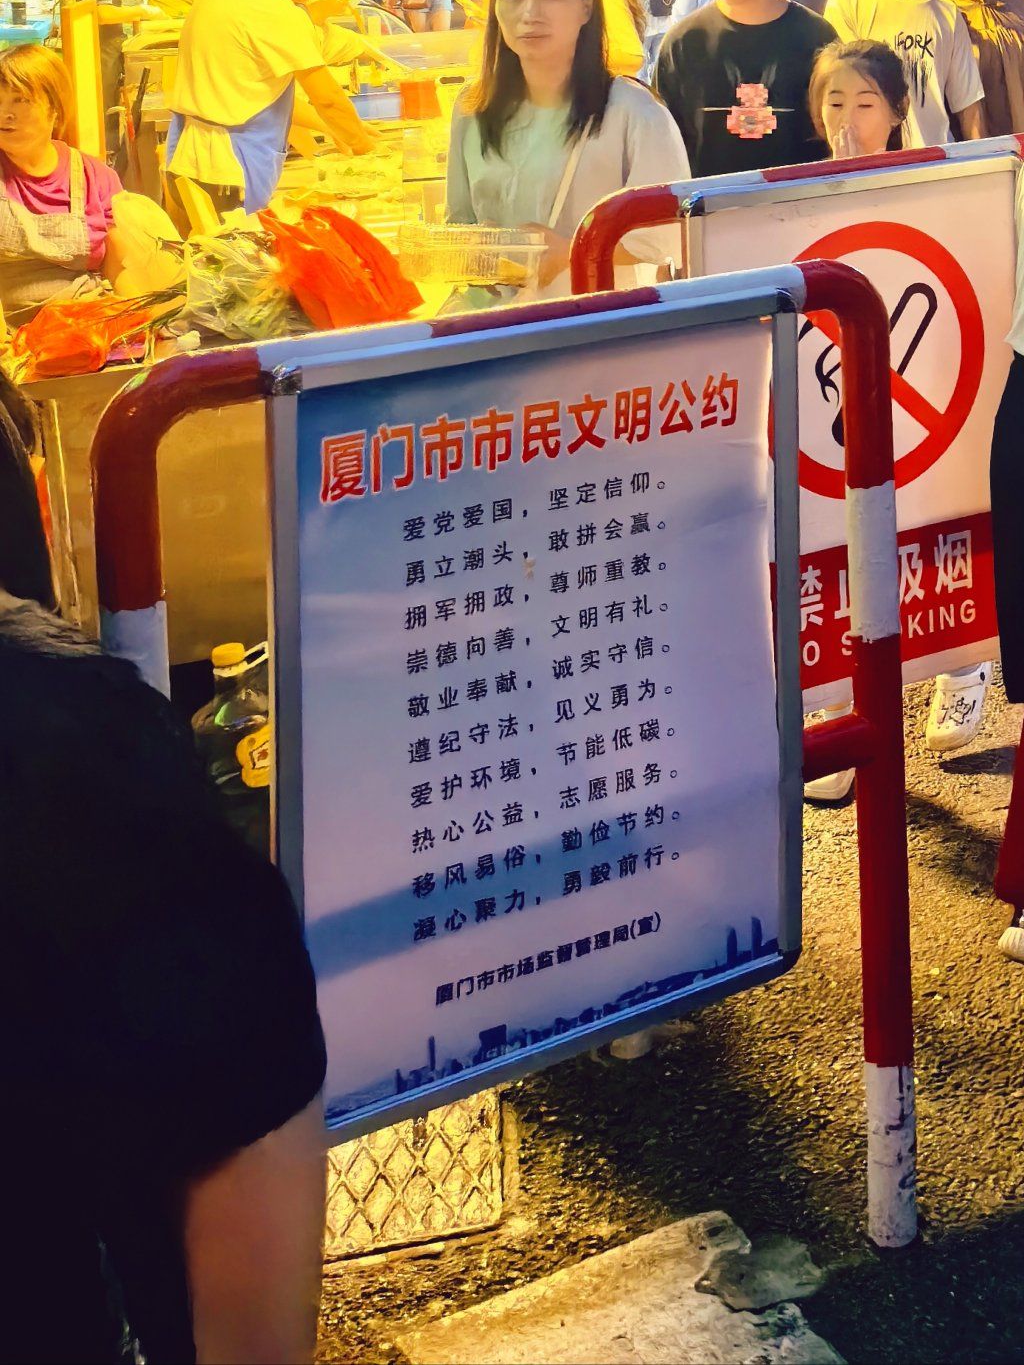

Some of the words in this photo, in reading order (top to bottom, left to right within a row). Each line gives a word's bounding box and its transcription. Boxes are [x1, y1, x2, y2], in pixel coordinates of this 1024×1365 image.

[320, 373, 740, 503] 厦门市市民文明公约
[403, 471, 666, 542] 爱党爱国，坚定信仰。
[404, 513, 666, 587] 勇立潮头，敢拼会赢。
[404, 553, 667, 630] 拥军拥政，尊师重教。
[406, 595, 669, 674] 崇德向善，文明有礼。
[801, 638, 820, 667] O
[841, 599, 977, 657] SKING
[407, 635, 671, 719] 敬业奉献，诚实守信。
[408, 678, 673, 764] 遵纪守法，见义勇为。
[410, 718, 676, 808] 爱护环境，节能低碳。
[412, 762, 678, 853] 热心公益，志愿服务。
[413, 804, 681, 899] 移风易俗，勤俭节约。
[414, 844, 681, 941] 凝心聚力，勇毅前行。
